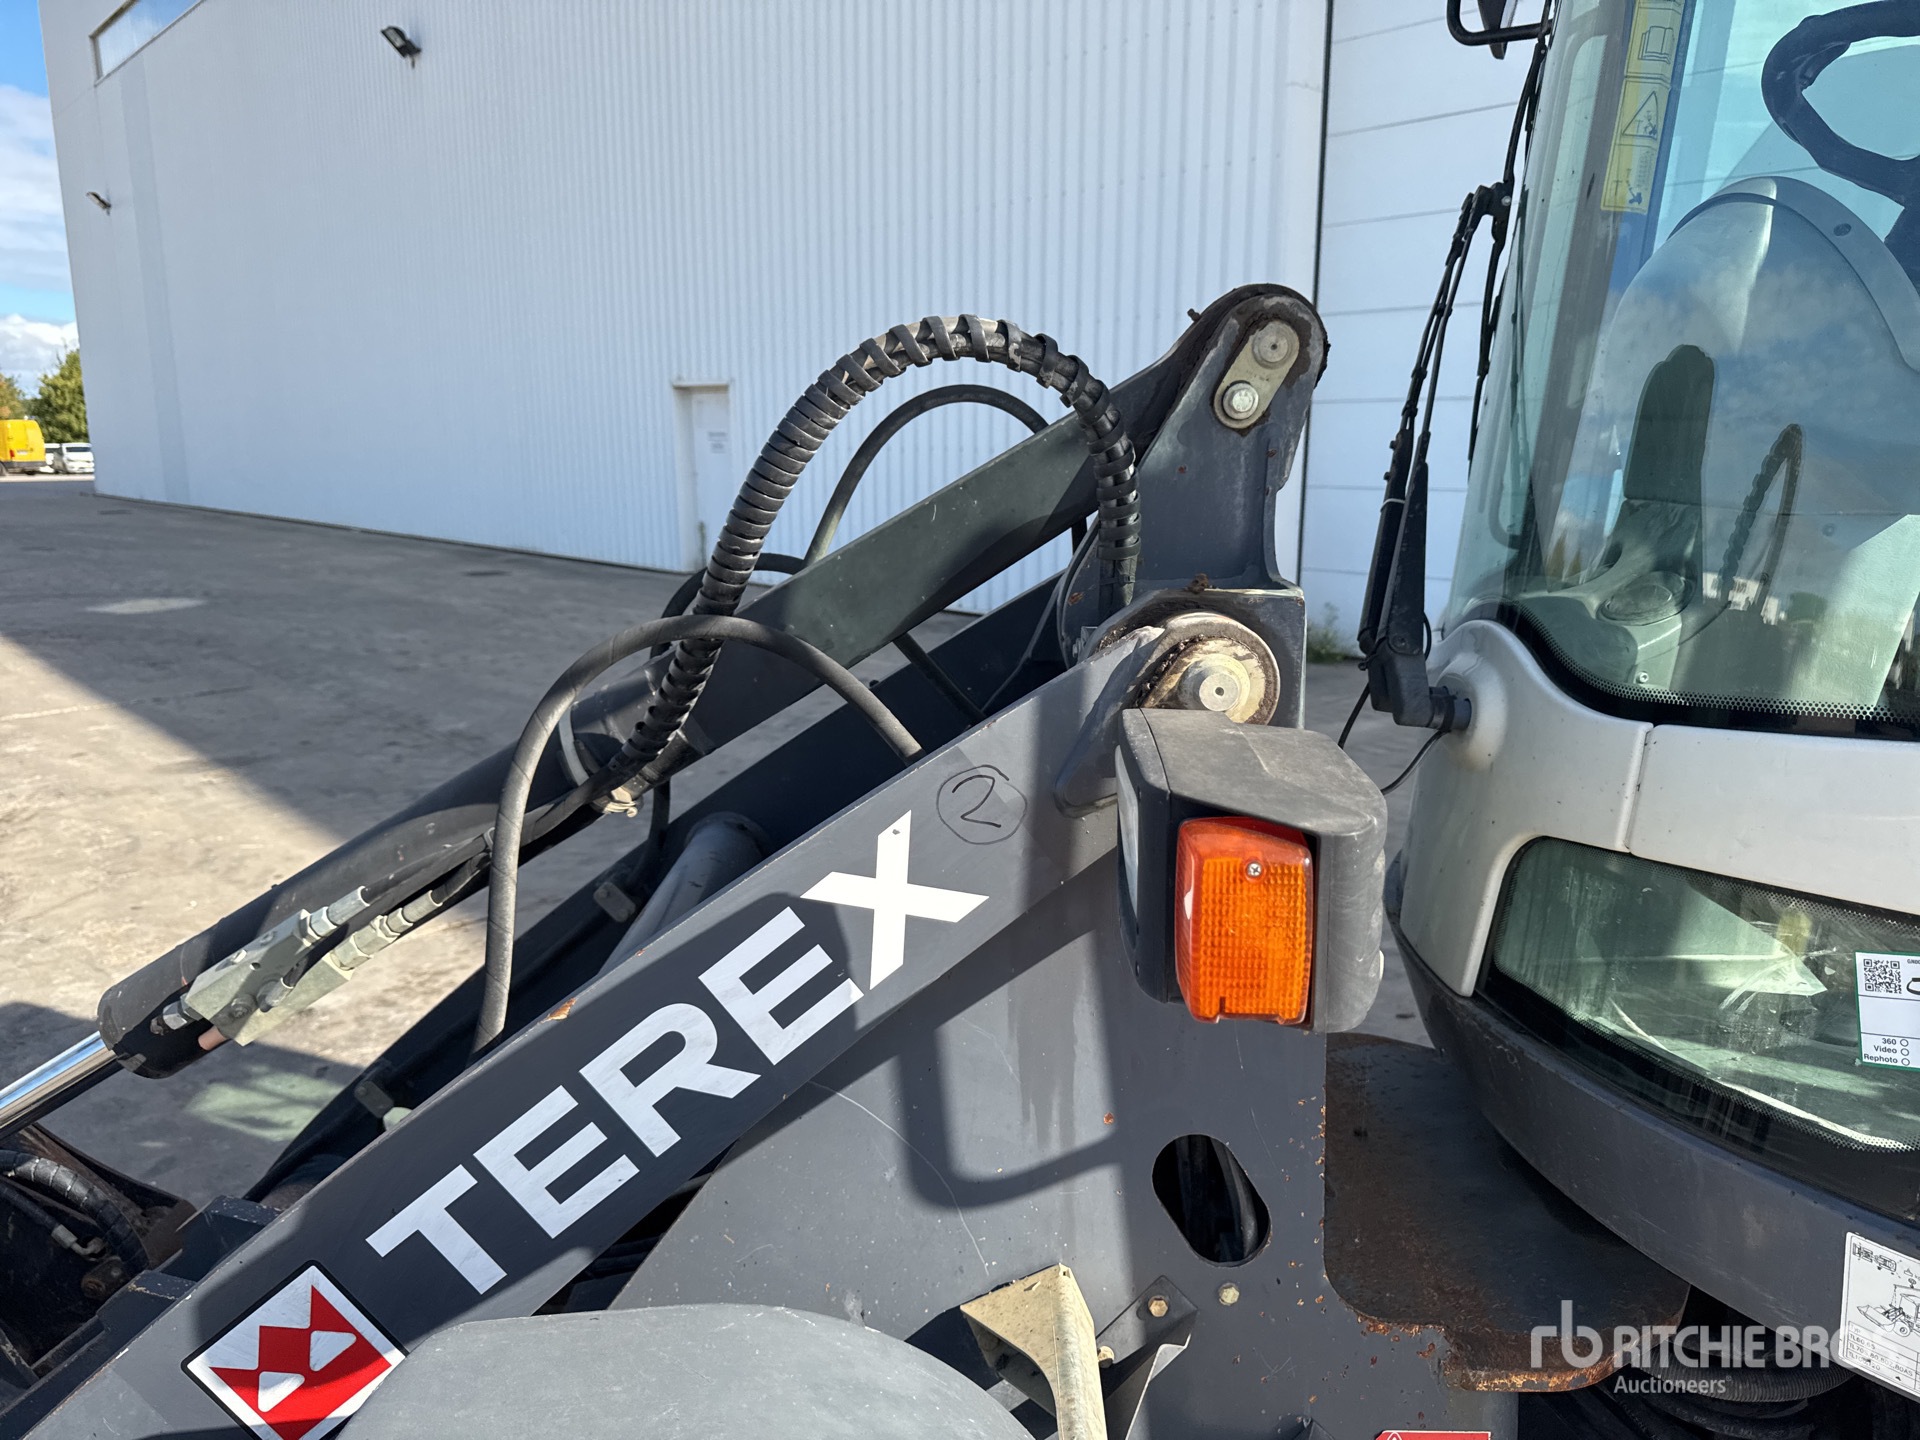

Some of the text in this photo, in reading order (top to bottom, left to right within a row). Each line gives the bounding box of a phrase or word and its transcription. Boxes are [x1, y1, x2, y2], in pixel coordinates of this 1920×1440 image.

[952, 775, 1001, 828] 2
[1881, 1037, 1897, 1045] 360
[365, 809, 990, 1295] TEREX
[1873, 1045, 1897, 1054] Video
[1863, 1053, 1898, 1064] Rephoto
